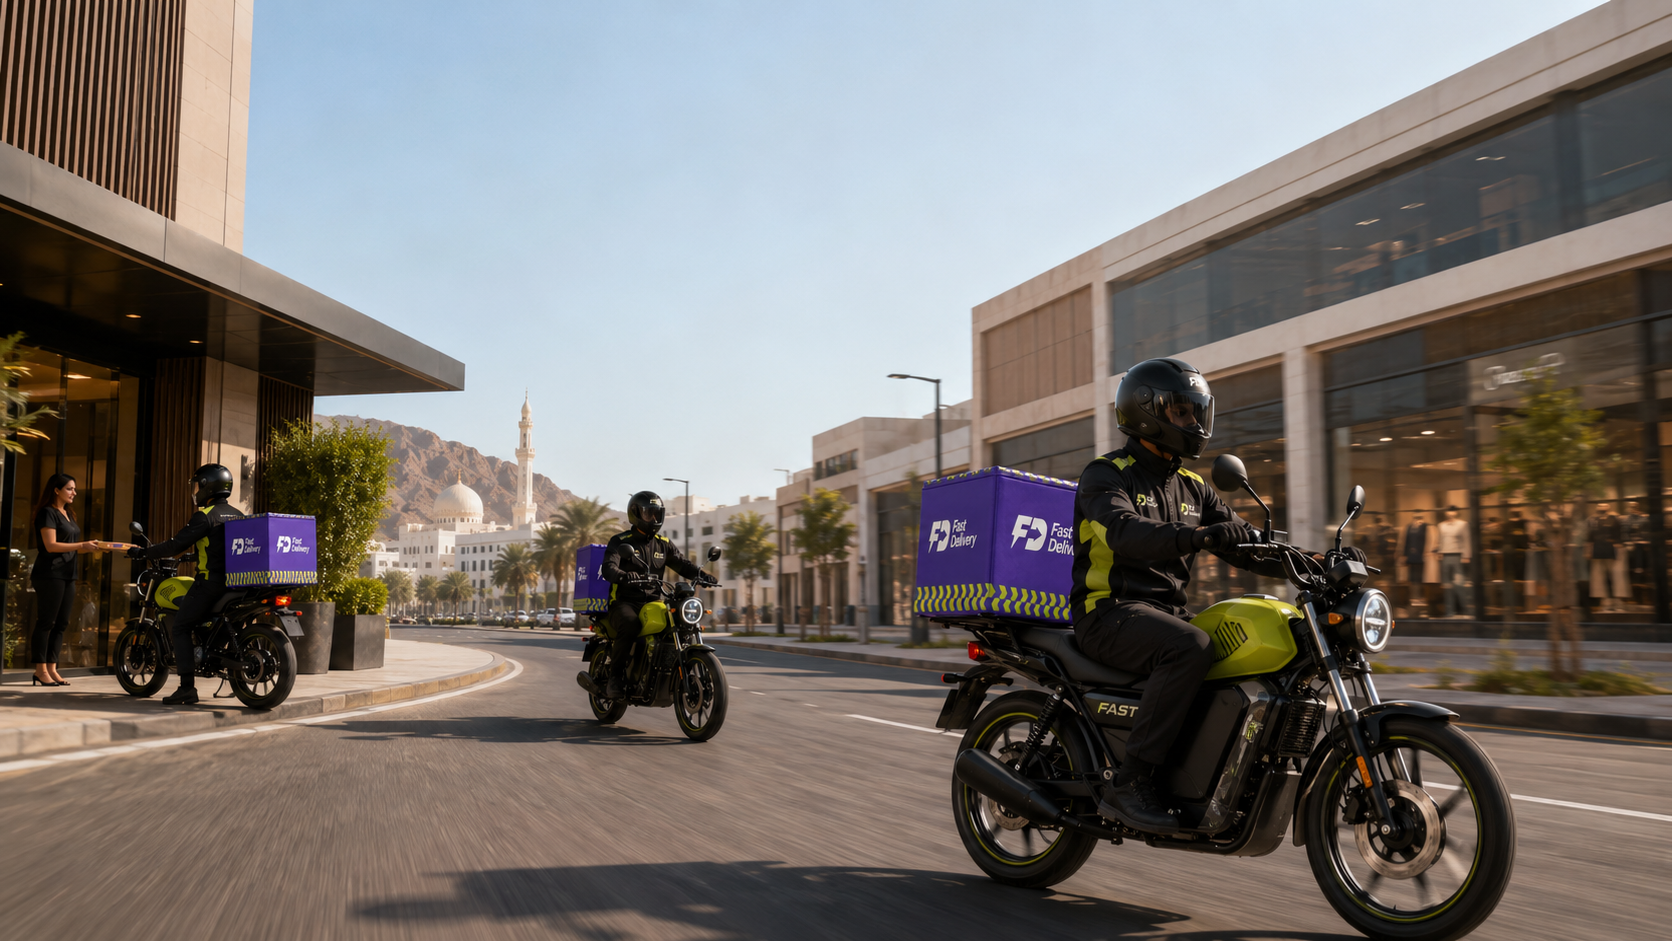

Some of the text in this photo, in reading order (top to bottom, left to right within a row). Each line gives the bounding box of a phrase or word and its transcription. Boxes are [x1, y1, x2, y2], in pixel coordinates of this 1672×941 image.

[952, 519, 967, 533] Fast
[1010, 514, 1048, 551] FD
[1051, 522, 1074, 539] Fast
[276, 535, 291, 553] FD
[928, 519, 951, 553] FD
[950, 532, 977, 548] Delivery
[231, 537, 245, 555] FD
[1047, 538, 1075, 556] Deliv
[1097, 702, 1139, 718] FAST
